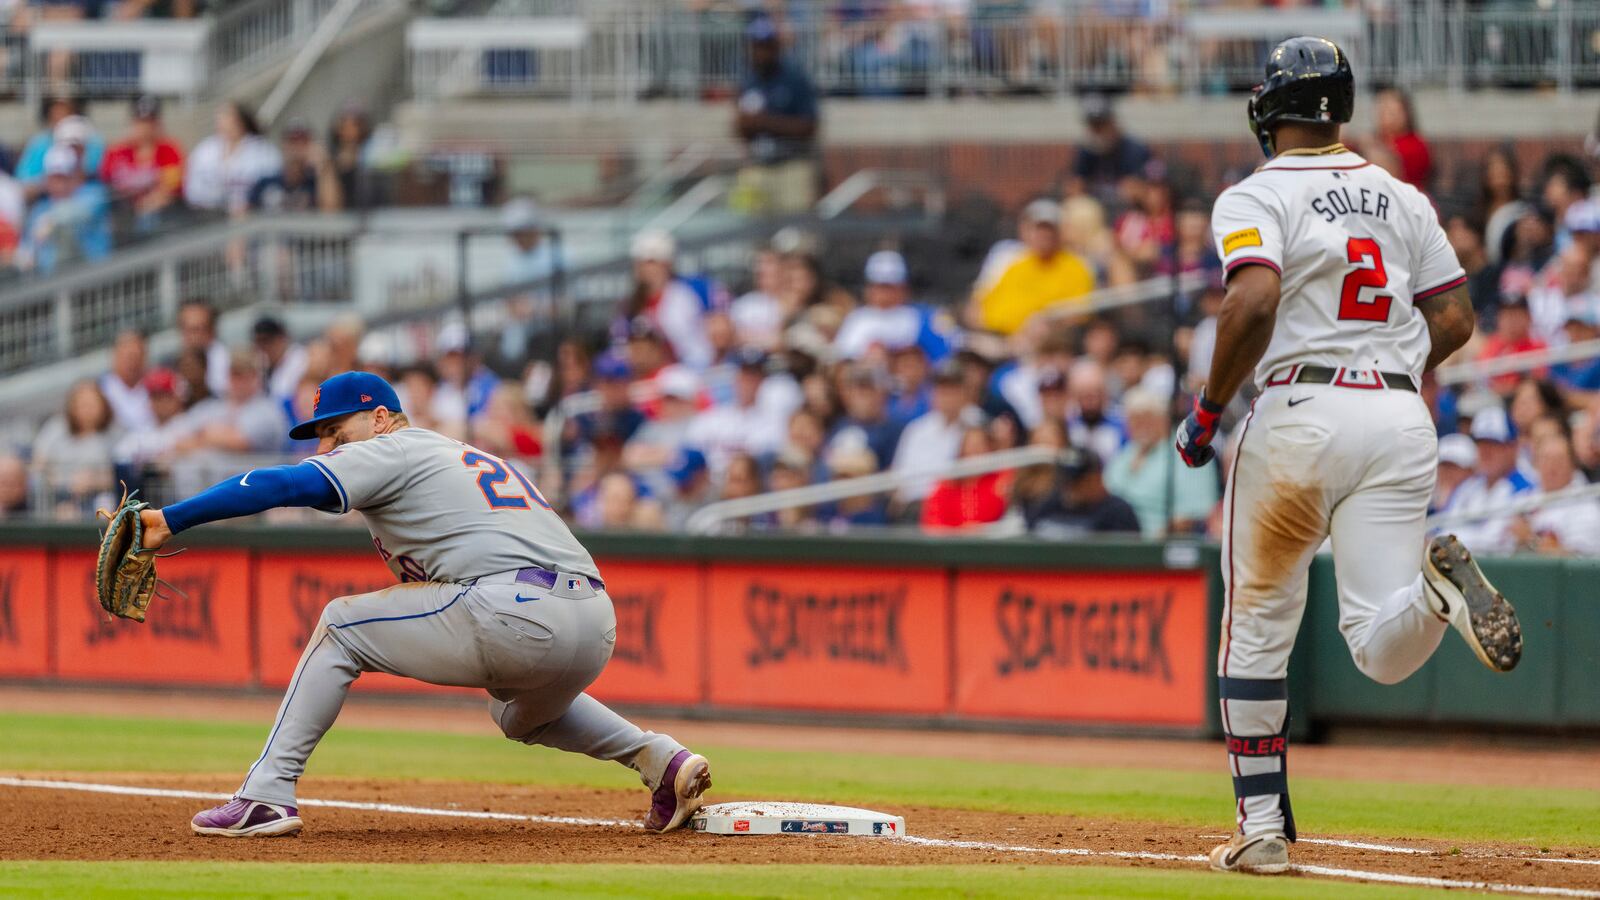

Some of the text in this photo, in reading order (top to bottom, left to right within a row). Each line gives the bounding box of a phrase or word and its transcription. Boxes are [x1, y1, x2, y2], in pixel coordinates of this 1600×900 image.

[1320, 96, 1328, 111] 2
[1311, 187, 1390, 223] SOLER
[1337, 236, 1393, 323] 2
[745, 578, 910, 677] SEATGEEK
[997, 587, 1174, 684] SEATGEEK
